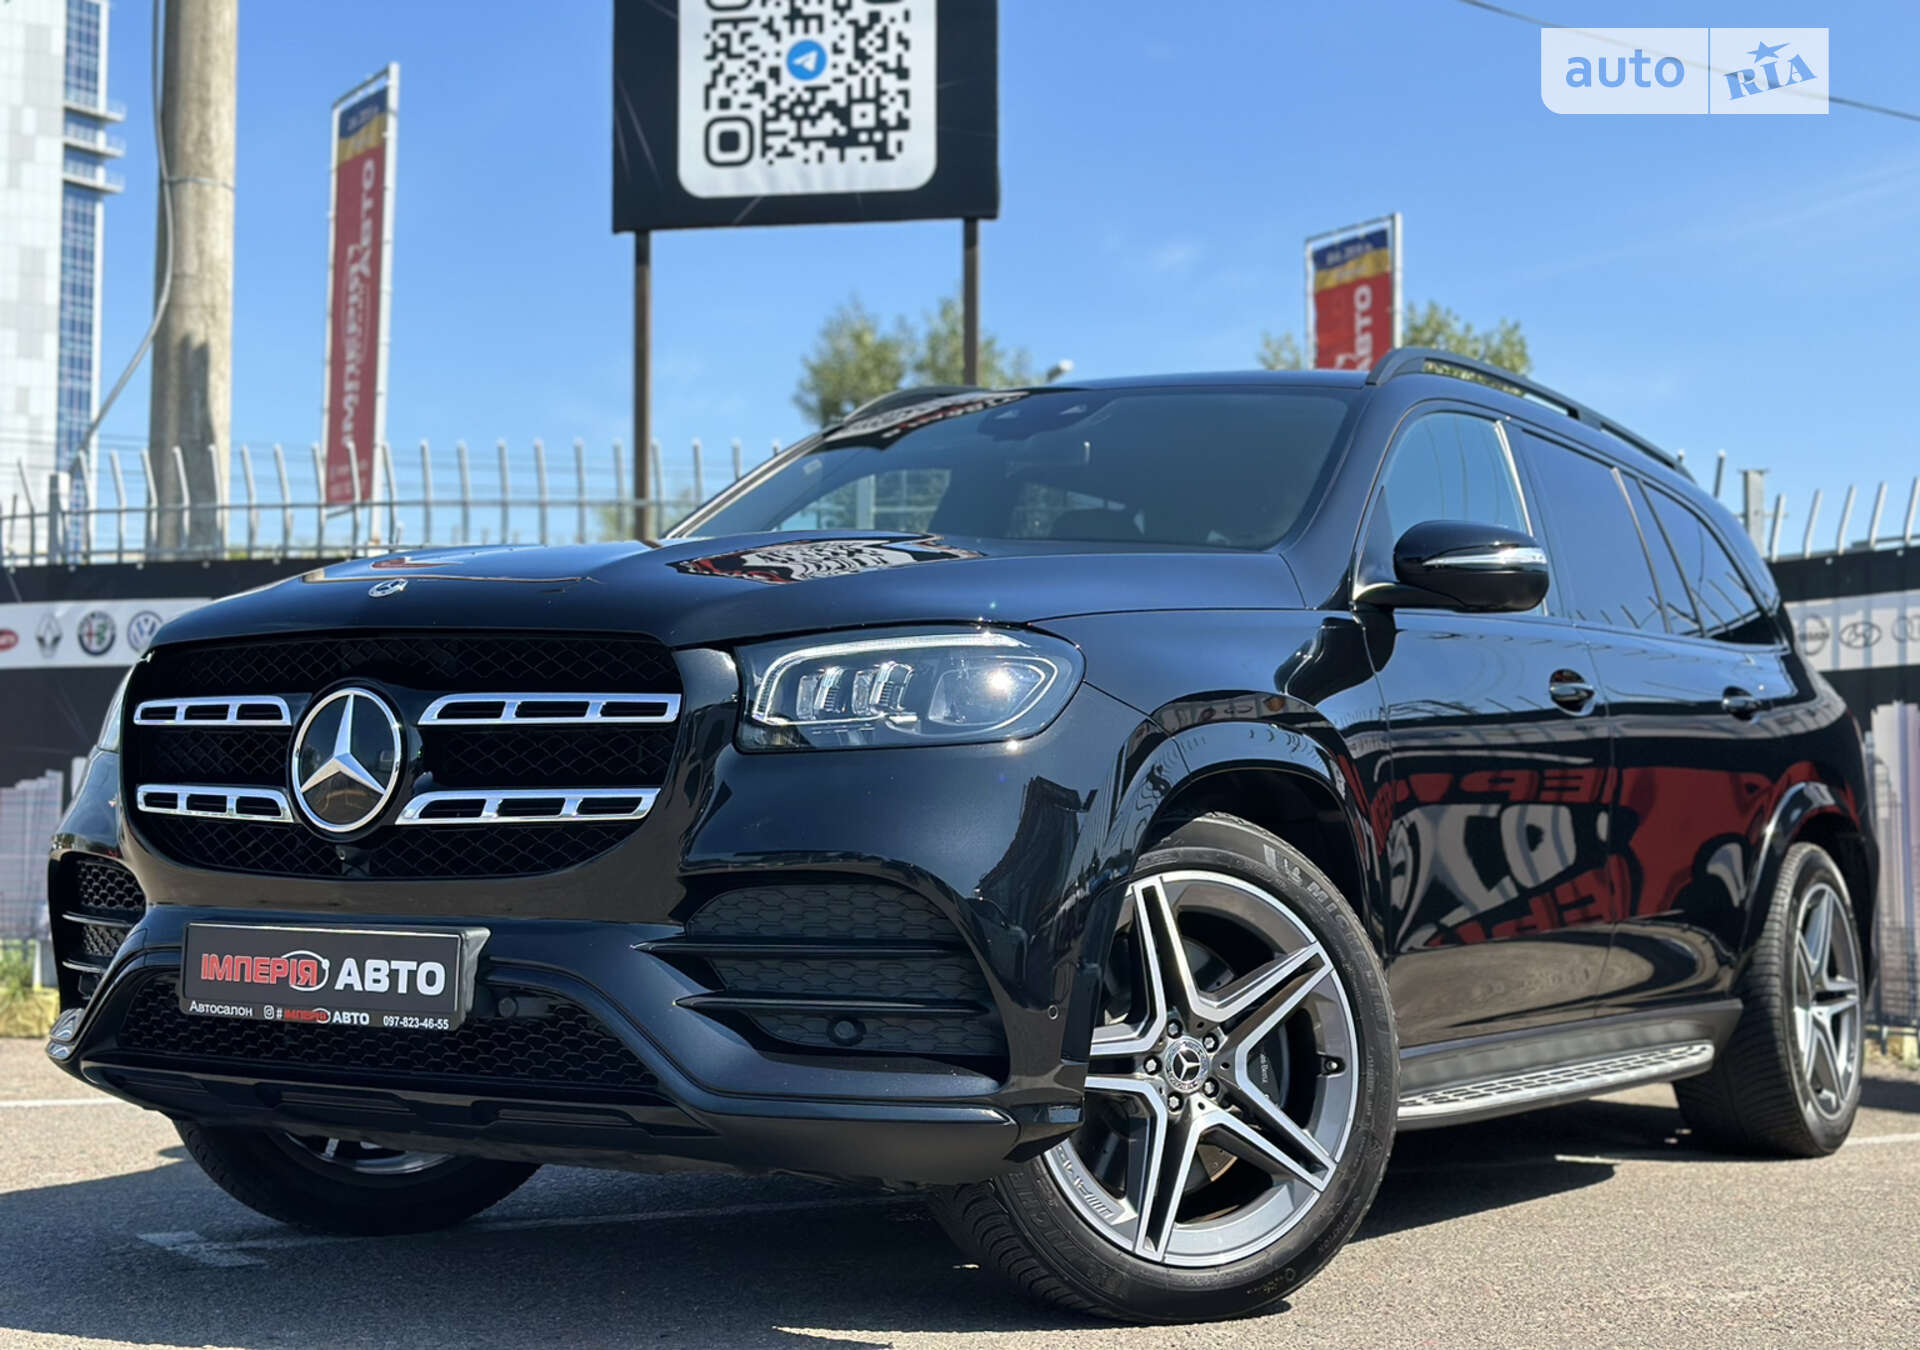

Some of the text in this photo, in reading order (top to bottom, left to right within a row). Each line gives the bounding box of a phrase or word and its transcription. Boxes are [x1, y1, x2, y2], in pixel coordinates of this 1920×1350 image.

[201, 953, 446, 996] ІМПЕРІЯ АВТО
[189, 1000, 254, 1018] Автосалон
[332, 1011, 370, 1026] АВТО
[383, 1015, 449, 1031] 097-823-46-55
